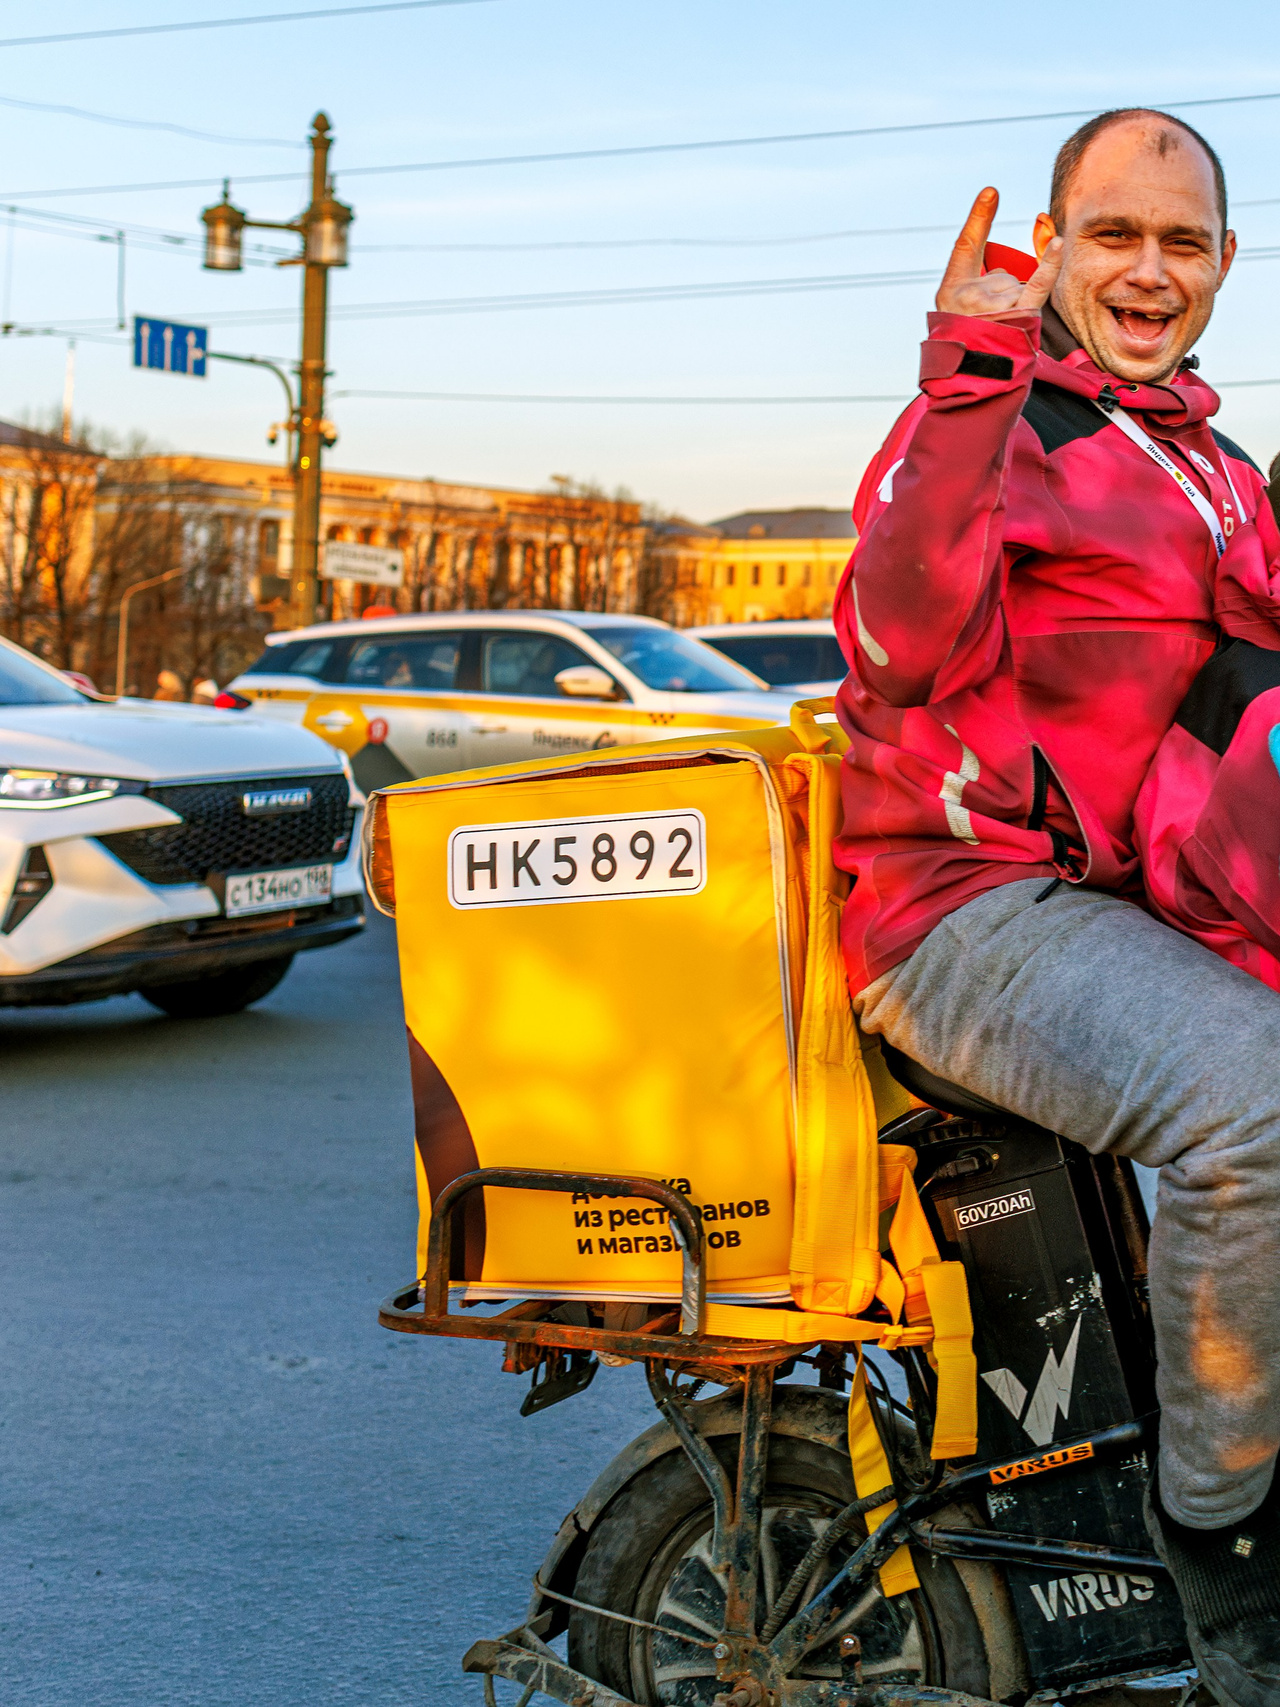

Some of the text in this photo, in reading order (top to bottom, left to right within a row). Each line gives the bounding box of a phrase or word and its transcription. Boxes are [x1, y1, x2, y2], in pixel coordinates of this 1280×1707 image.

[574, 1198, 771, 1232] из рестанов
[958, 1194, 1031, 1225] 60V20Ah
[577, 1230, 742, 1255] и магазов
[992, 1445, 1092, 1480] VIRUS
[1029, 1573, 1155, 1622] VIRUS
